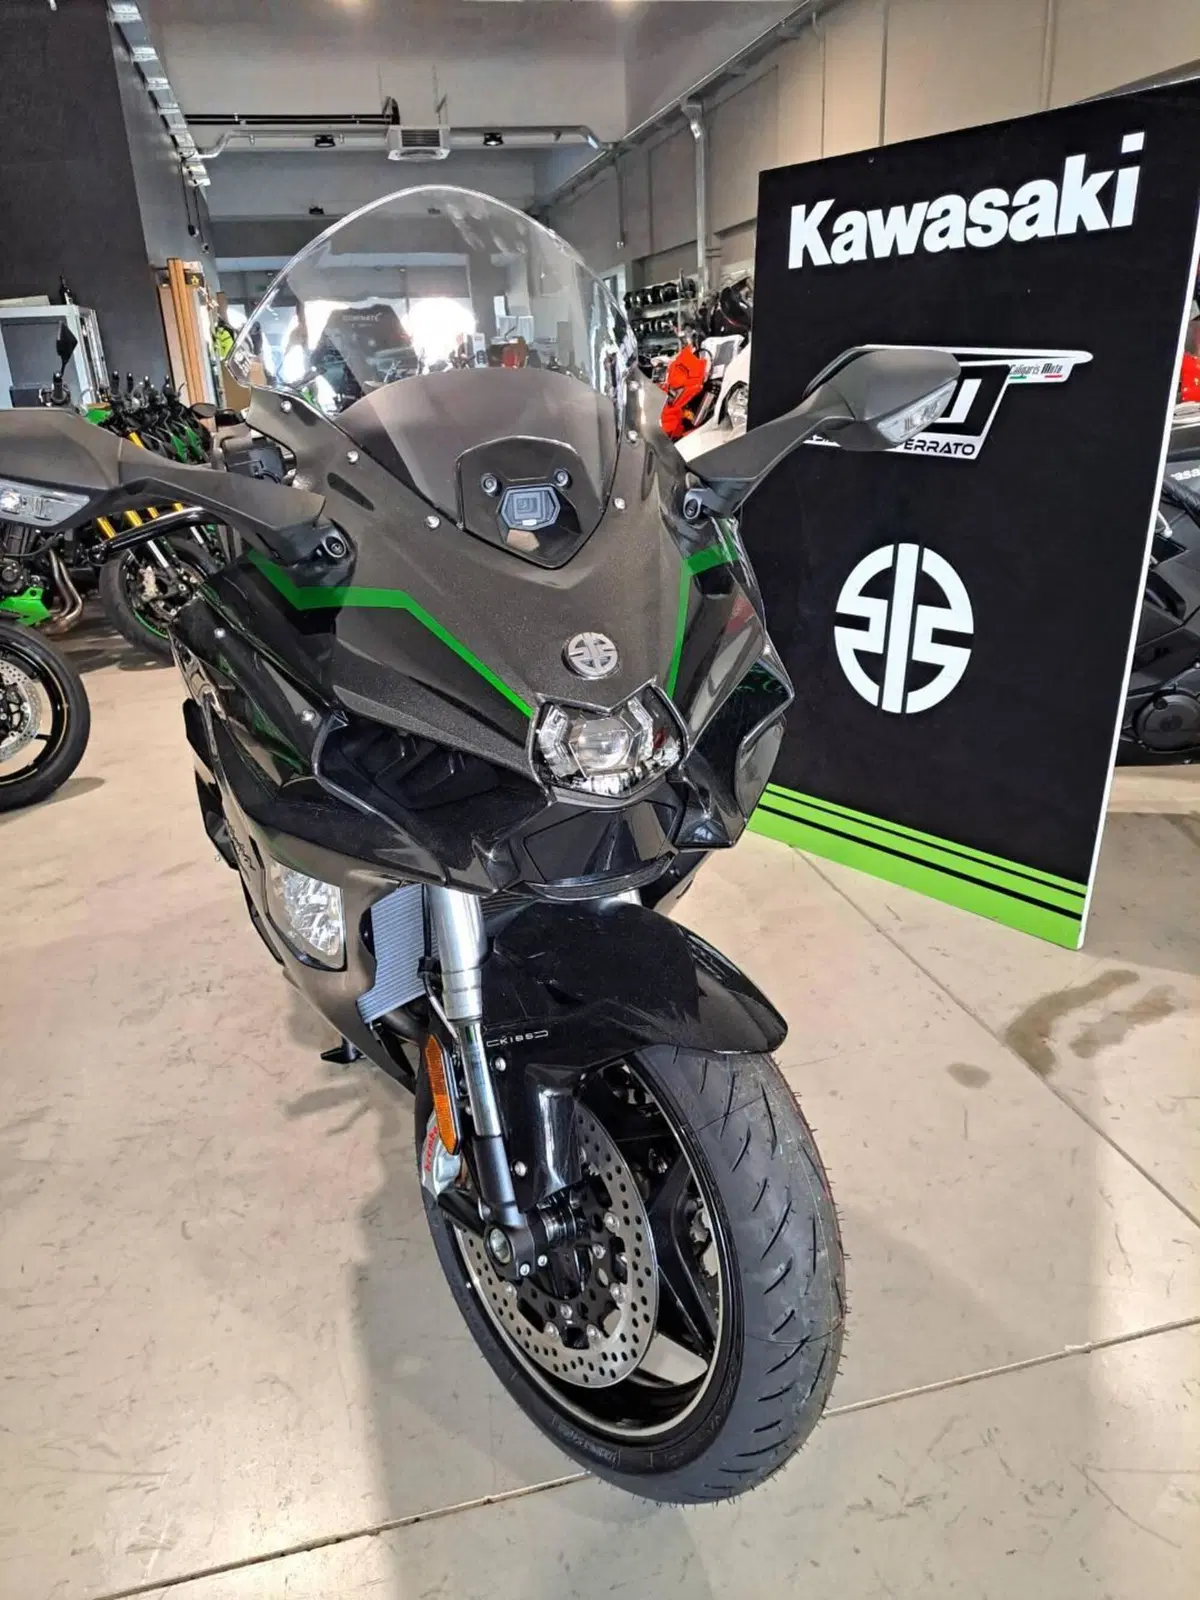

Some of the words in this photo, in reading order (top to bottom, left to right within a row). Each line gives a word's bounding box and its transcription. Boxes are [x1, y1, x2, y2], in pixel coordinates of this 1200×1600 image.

[788, 131, 1145, 269] Kawasaki
[1041, 363, 1063, 374] Moto
[903, 438, 976, 456] ERRATO
